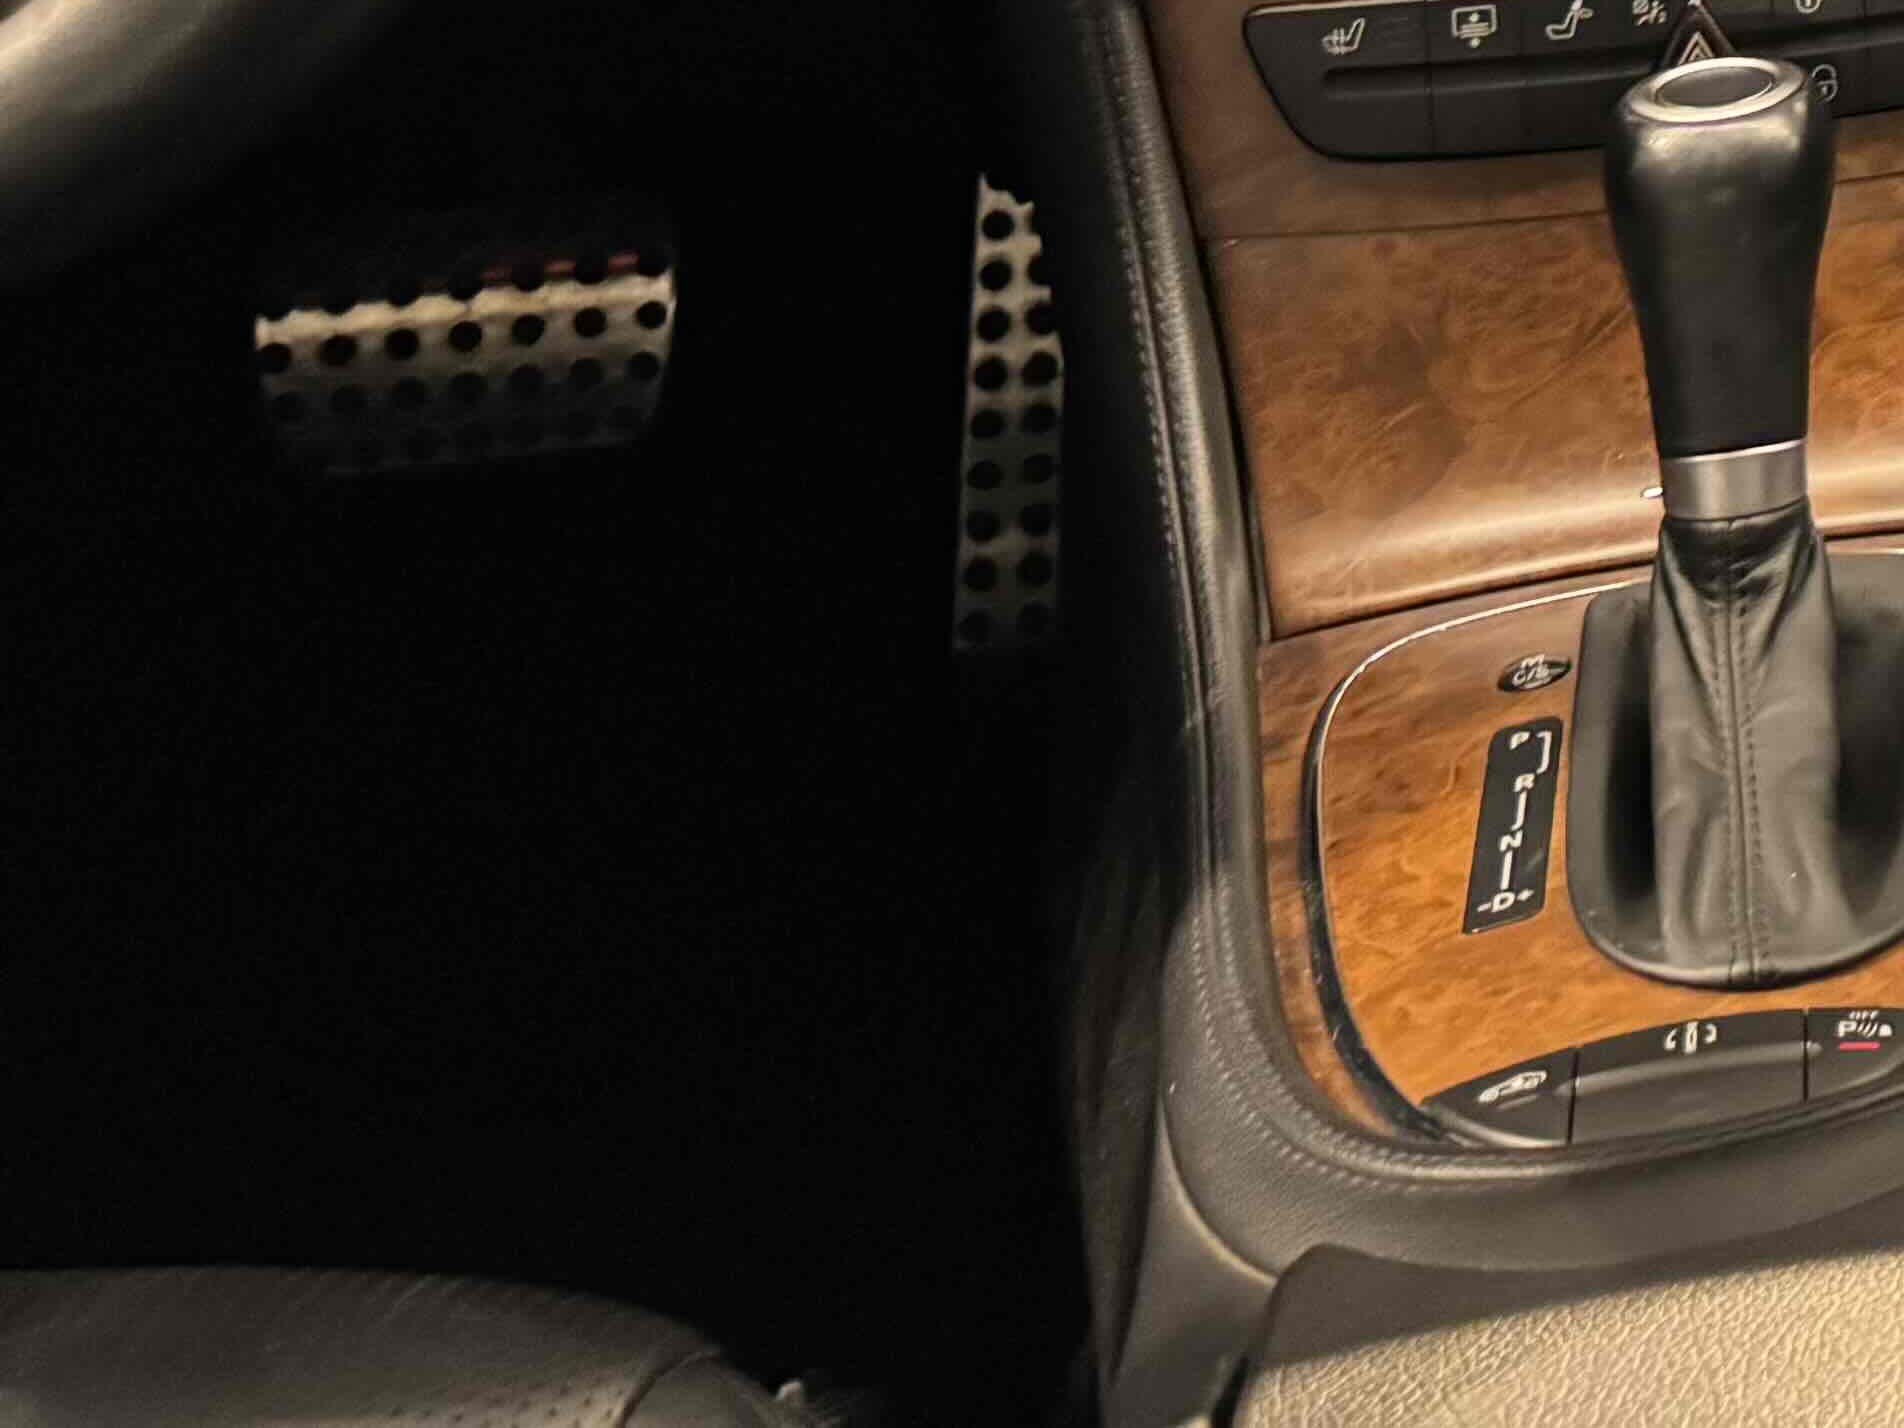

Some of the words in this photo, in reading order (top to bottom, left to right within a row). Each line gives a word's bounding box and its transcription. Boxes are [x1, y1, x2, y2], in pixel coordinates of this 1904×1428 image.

[1510, 730, 1530, 750] P
[1514, 773, 1535, 792] R
[1499, 828, 1523, 852] N
